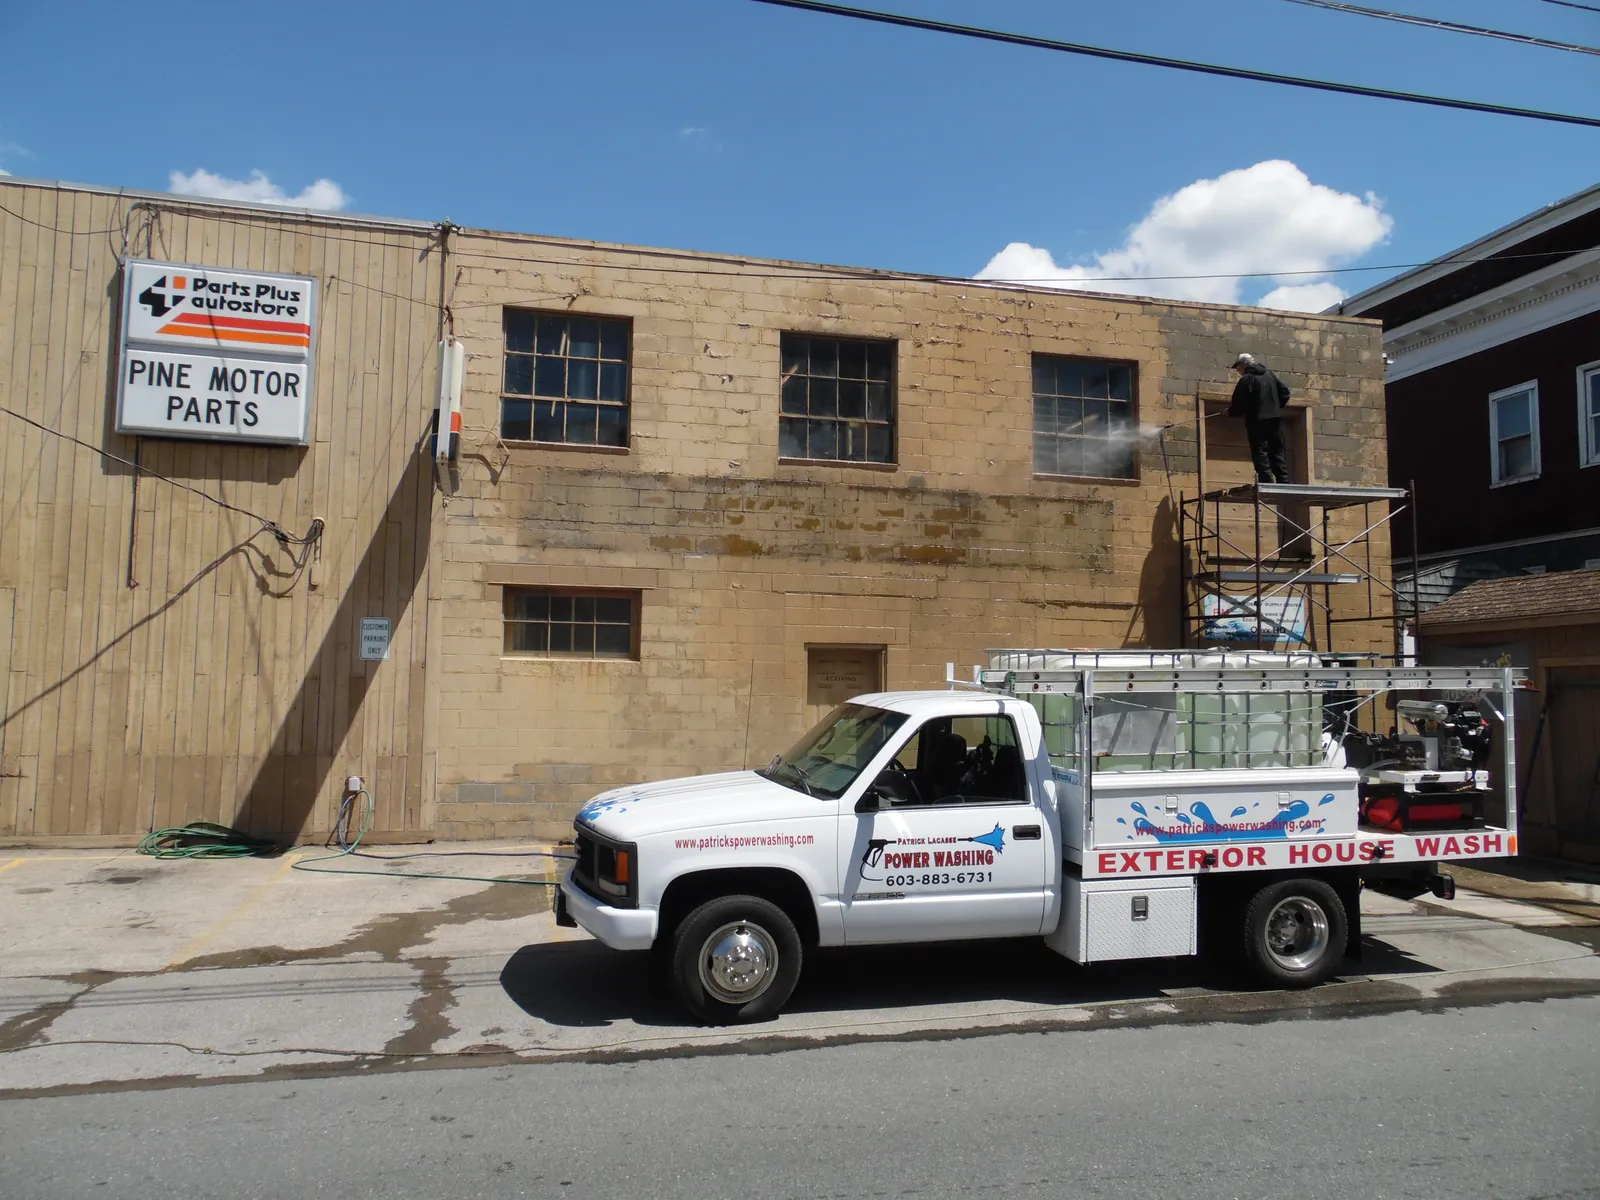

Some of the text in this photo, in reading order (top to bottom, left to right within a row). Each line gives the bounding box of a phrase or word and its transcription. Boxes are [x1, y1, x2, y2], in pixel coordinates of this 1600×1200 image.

[193, 278, 300, 302] Parts Plus
[191, 296, 298, 317] autostore
[128, 359, 300, 397] PINE MOTOR
[166, 395, 259, 427] PARTS
[1135, 818, 1322, 838] www.patrickspowerwashing.com
[675, 833, 814, 851] www.patrickspowerwashing.com
[884, 849, 994, 869] POWER WASHING
[1098, 834, 1502, 874] EXTERIOR HOUSE WASH
[886, 871, 993, 887] 603-883-6731
